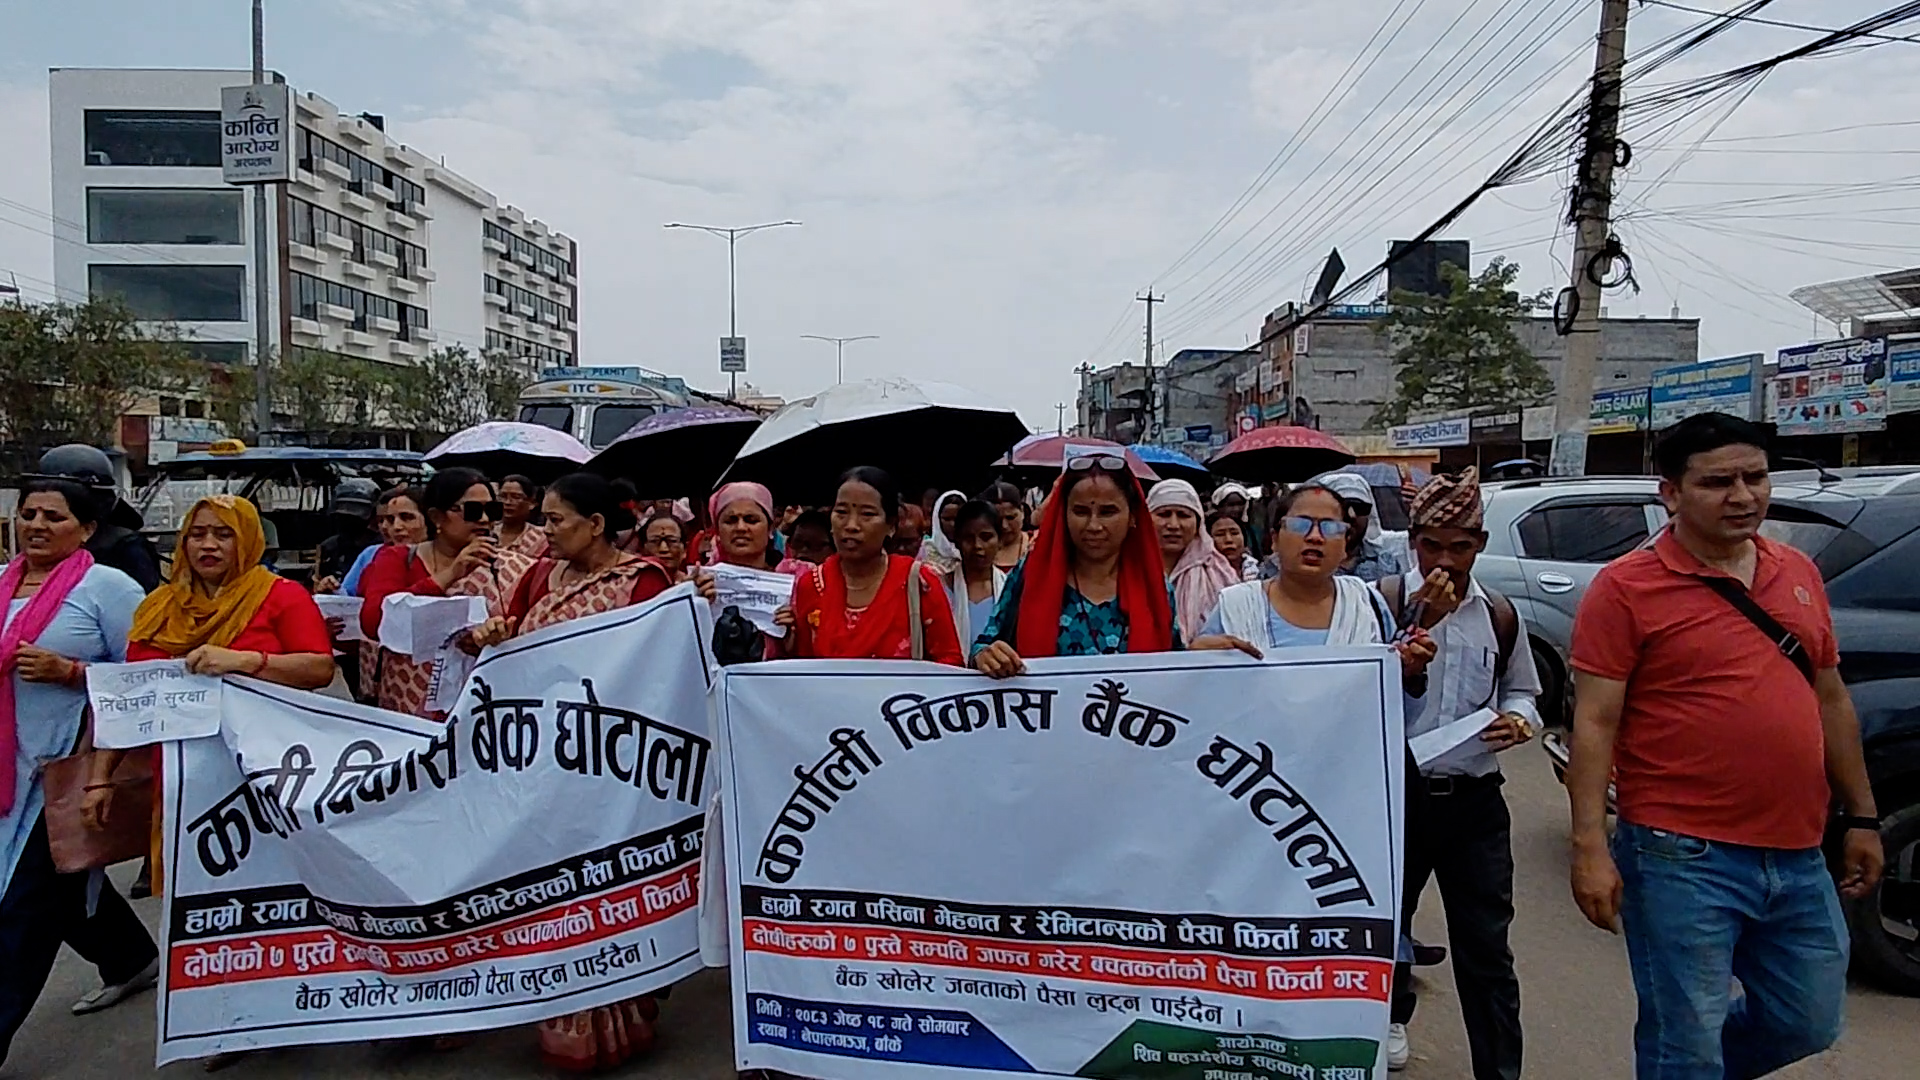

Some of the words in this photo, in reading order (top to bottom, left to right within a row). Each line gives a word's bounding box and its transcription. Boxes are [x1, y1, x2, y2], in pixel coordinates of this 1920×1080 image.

[224, 114, 280, 136] कान्ति
[224, 138, 280, 154] आरोग्य
[573, 384, 596, 393] ITC
[592, 367, 627, 377] PERMIT
[1613, 394, 1648, 411] GALAXY
[163, 689, 207, 708] सुरक्षा
[555, 678, 711, 807] घोटाला
[755, 727, 883, 884] कर्णाली
[880, 688, 1059, 751] विकास
[1196, 734, 1376, 908] घोटाला
[184, 898, 245, 934] हाम्रो
[252, 898, 310, 924] रगत
[360, 912, 428, 936] मेहनत
[431, 911, 451, 929] र
[453, 866, 577, 924] रेमिटेन्सको
[582, 860, 614, 886] पैसा
[619, 834, 677, 875] फिर्ता
[183, 940, 264, 979] दोषीको
[269, 946, 285, 968] ७
[293, 934, 338, 973] पुस्ते
[392, 946, 449, 968] जफत
[451, 935, 499, 959] गरेर
[500, 905, 594, 946] बचतकर्ताको
[599, 897, 639, 926] पैसा
[642, 874, 691, 914] फिर्ता
[760, 893, 802, 918] हाम्रो
[810, 898, 857, 918] रगत
[865, 897, 926, 924] पसिना
[933, 904, 1001, 932] मेहनत
[1009, 915, 1027, 935] र
[1035, 910, 1167, 943] रेमिटान्सको
[1176, 918, 1225, 945] पैसा
[1233, 922, 1300, 950] फिर्ता
[1309, 928, 1350, 949] गर
[844, 937, 856, 951] ७
[865, 933, 902, 957] पुस्ते
[908, 940, 969, 962] सम्पति
[975, 946, 1030, 967] जफत
[1037, 949, 1083, 973] गरेर
[1090, 955, 1207, 981] बचतकर्ताको
[1216, 959, 1257, 988] पैसा
[1266, 965, 1324, 991] फिर्ता
[1332, 970, 1369, 991] गर
[339, 977, 400, 1009] खोलेर
[407, 969, 480, 1004] जनताको
[485, 966, 515, 995] पैसा
[520, 962, 568, 995] लुट्न
[876, 969, 936, 993] खोलेर
[945, 976, 1027, 1002] जनताको
[1036, 981, 1076, 1006] पैसा
[1085, 991, 1140, 1014] लुट्न
[755, 998, 783, 1018] मिति
[867, 1016, 885, 1029] १८
[890, 1013, 913, 1033] गते
[756, 1021, 788, 1040] स्थान
[874, 1033, 903, 1053] बाँके
[1216, 1035, 1287, 1054] आयोजक
[1132, 1042, 1162, 1063] शिव
[1251, 1053, 1315, 1080] सहकारी
